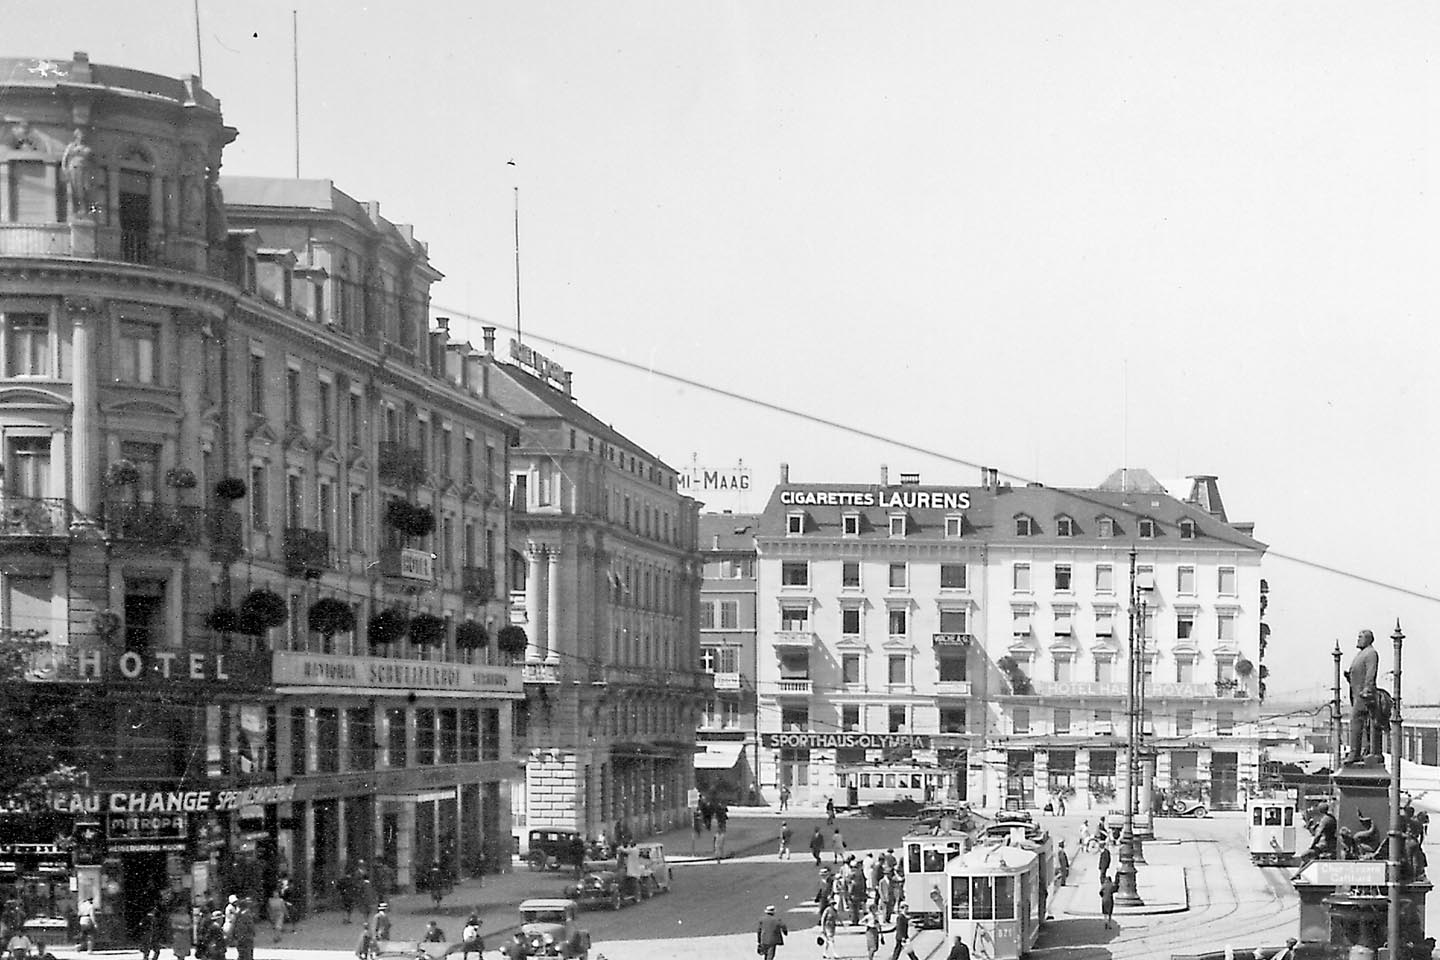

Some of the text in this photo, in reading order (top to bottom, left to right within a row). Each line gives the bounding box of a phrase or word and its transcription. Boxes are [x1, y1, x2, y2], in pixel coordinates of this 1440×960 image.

[780, 490, 970, 509] CIGARETTES LAURENS
[78, 650, 229, 680] HOTEL
[1047, 681, 1095, 697] HOTEL
[109, 790, 212, 812] CHANGE
